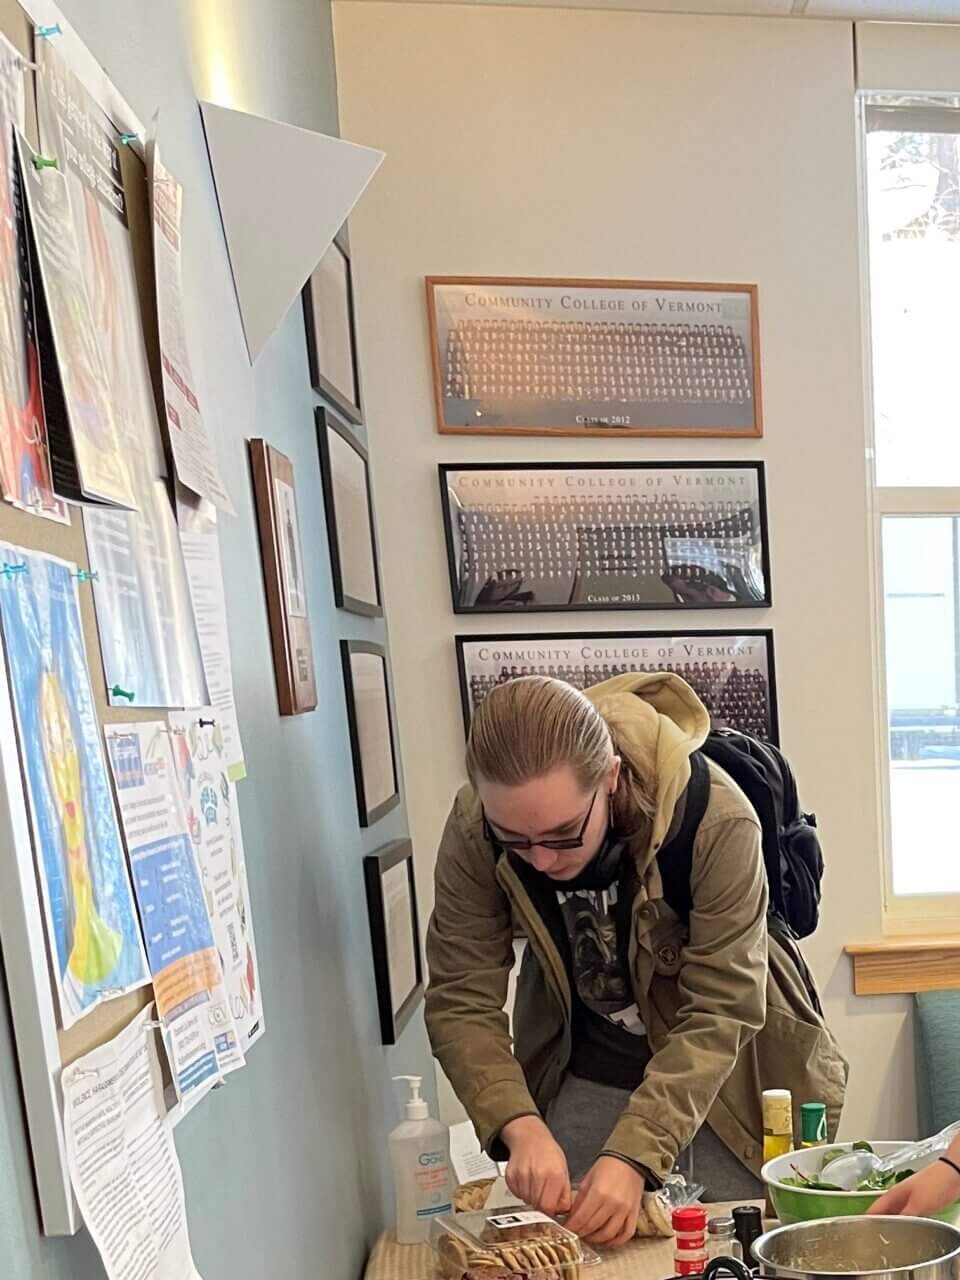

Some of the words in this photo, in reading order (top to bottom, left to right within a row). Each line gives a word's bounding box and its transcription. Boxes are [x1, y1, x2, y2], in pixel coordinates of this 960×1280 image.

[464, 294, 553, 310] COMMUNITY
[560, 295, 625, 311] COLLEGE
[655, 297, 724, 314] VERMONT
[457, 475, 556, 489] COMMUNITY
[564, 475, 637, 488] COLLEGE
[670, 475, 746, 487] VERMONT
[477, 647, 571, 662] COMMUNITY
[580, 646, 649, 660] COLLEGE
[682, 644, 755, 658] VERMONT
